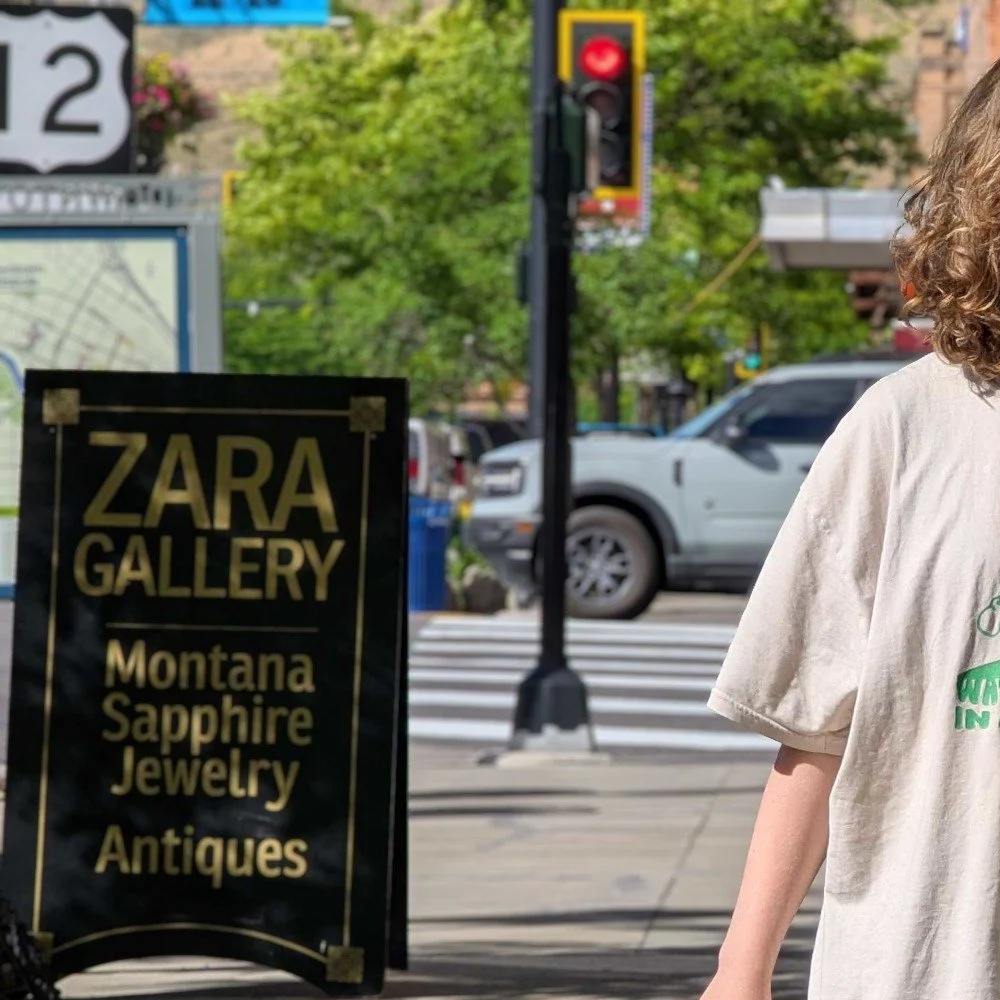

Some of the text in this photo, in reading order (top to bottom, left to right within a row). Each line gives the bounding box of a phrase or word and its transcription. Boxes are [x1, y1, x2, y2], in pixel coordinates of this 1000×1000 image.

[0, 43, 101, 133] 12
[83, 432, 339, 533] ZARA
[73, 534, 345, 600] GALLERY
[106, 639, 315, 693] Montana
[102, 693, 314, 755] Sapphire
[955, 706, 990, 730] IN
[110, 746, 300, 812] Jewelry
[95, 825, 308, 888] Antiques
